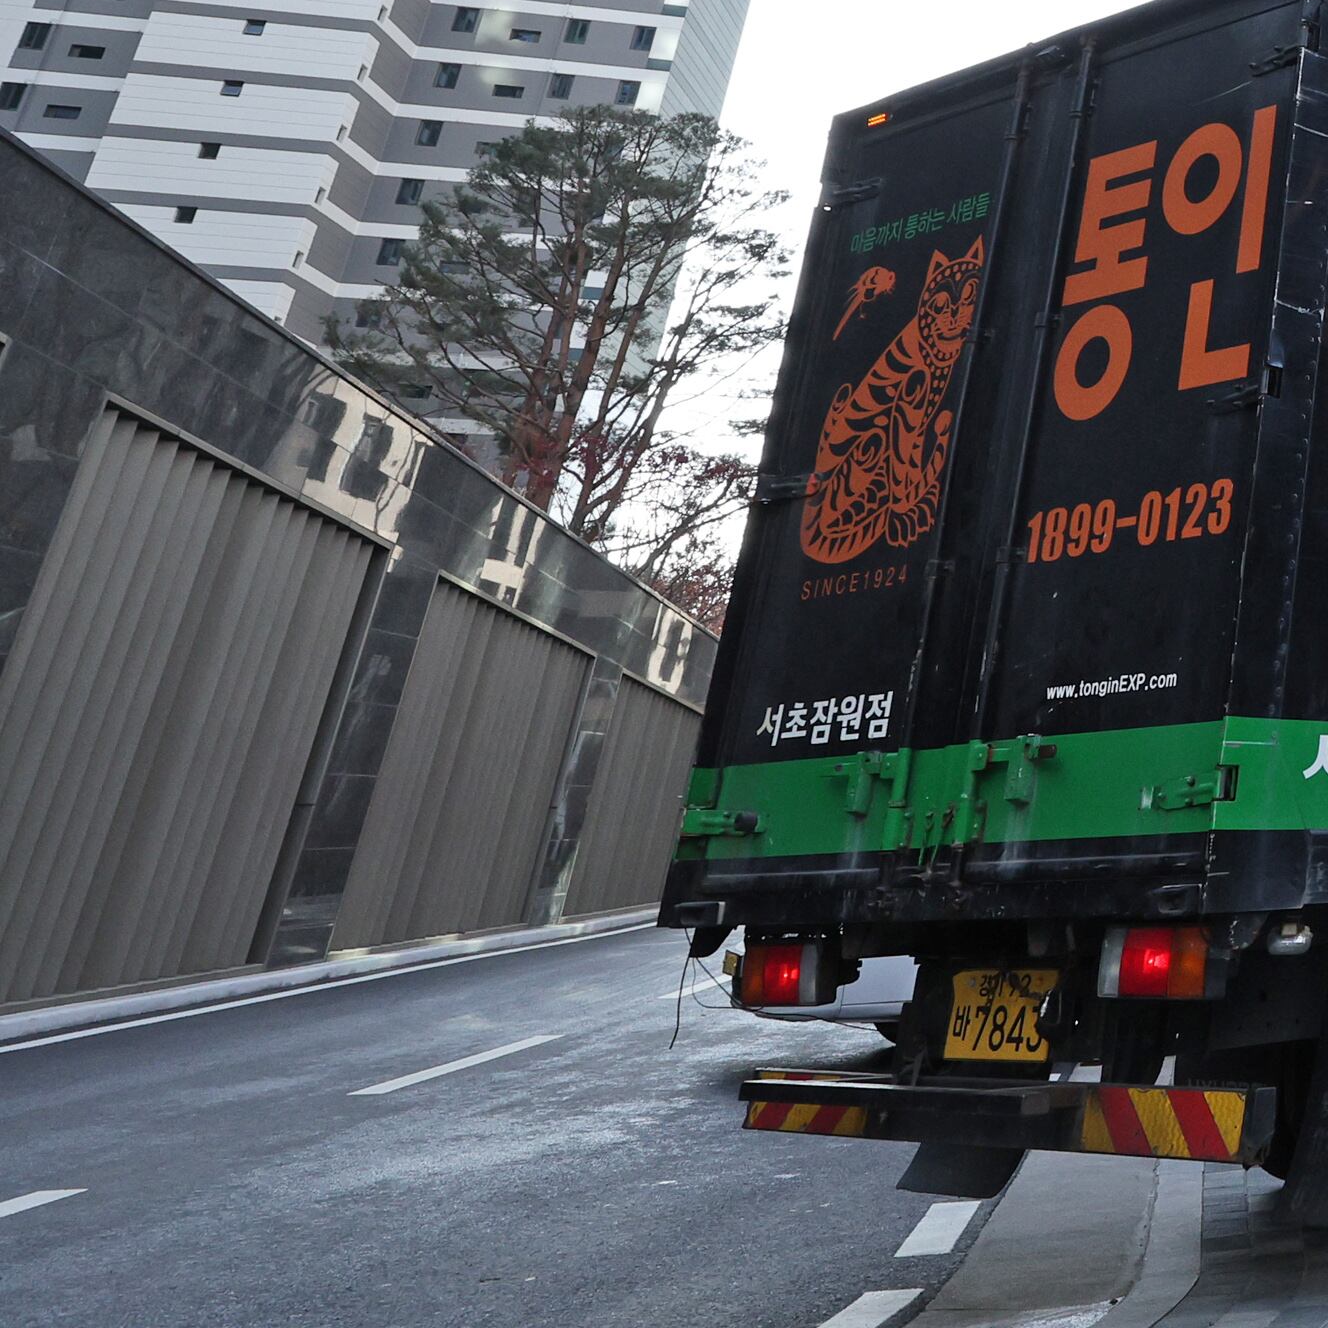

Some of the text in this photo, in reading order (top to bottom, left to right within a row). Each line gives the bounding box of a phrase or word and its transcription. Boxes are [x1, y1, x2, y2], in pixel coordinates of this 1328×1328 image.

[850, 192, 990, 253] 마음까지 통하는 사람들
[1026, 478, 1234, 564] 1899-0123
[1046, 673, 1177, 700] www.tonginEXP.com
[756, 691, 894, 746] 서초잠원점
